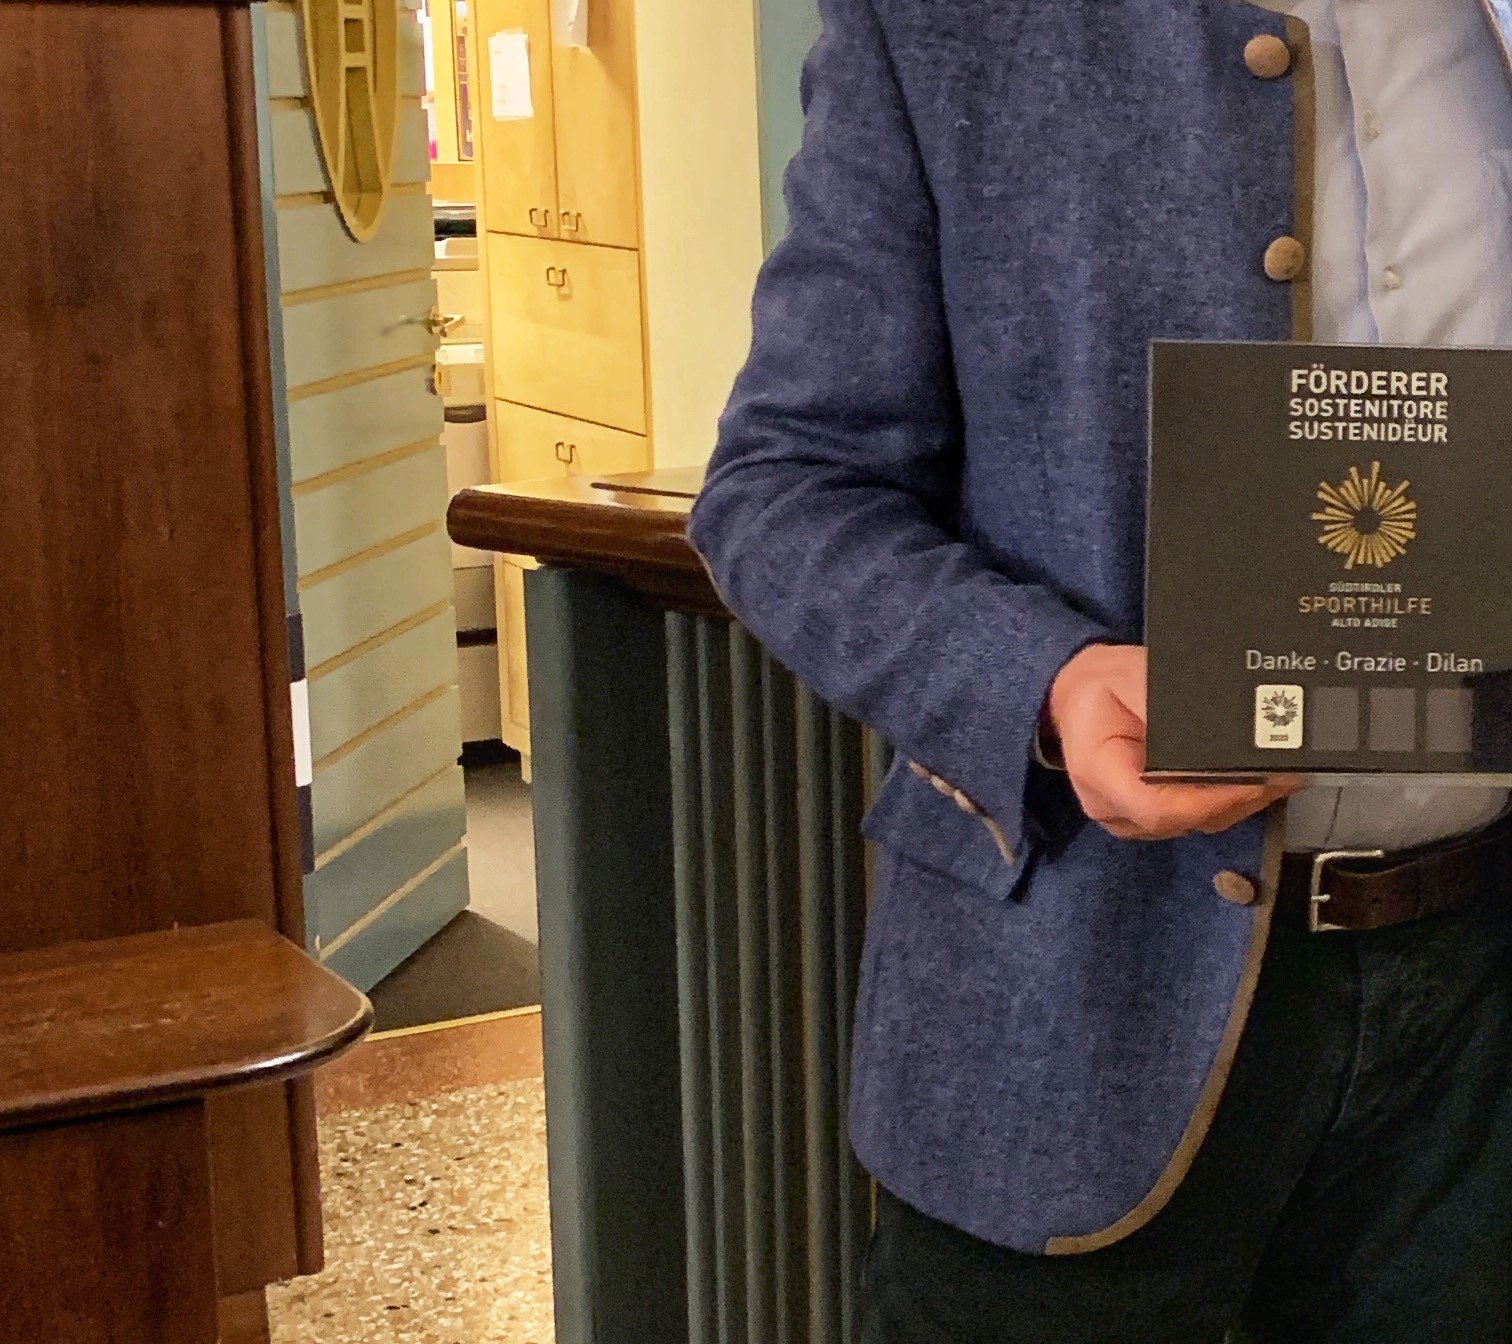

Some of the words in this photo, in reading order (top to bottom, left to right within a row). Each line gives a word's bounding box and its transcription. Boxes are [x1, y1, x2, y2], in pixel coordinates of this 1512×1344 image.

[1291, 363, 1448, 396] FÖRDERER
[1289, 398, 1448, 419] SOSTENITORE
[1289, 419, 1448, 442] SUSTENIDËUR
[1299, 596, 1432, 615] SPORTHILFE
[1331, 618, 1361, 628] ALTO
[1364, 618, 1399, 628] ADIGE
[1246, 650, 1316, 670] Danke
[1336, 651, 1407, 671] Grazie
[1426, 653, 1484, 672] Dilan
